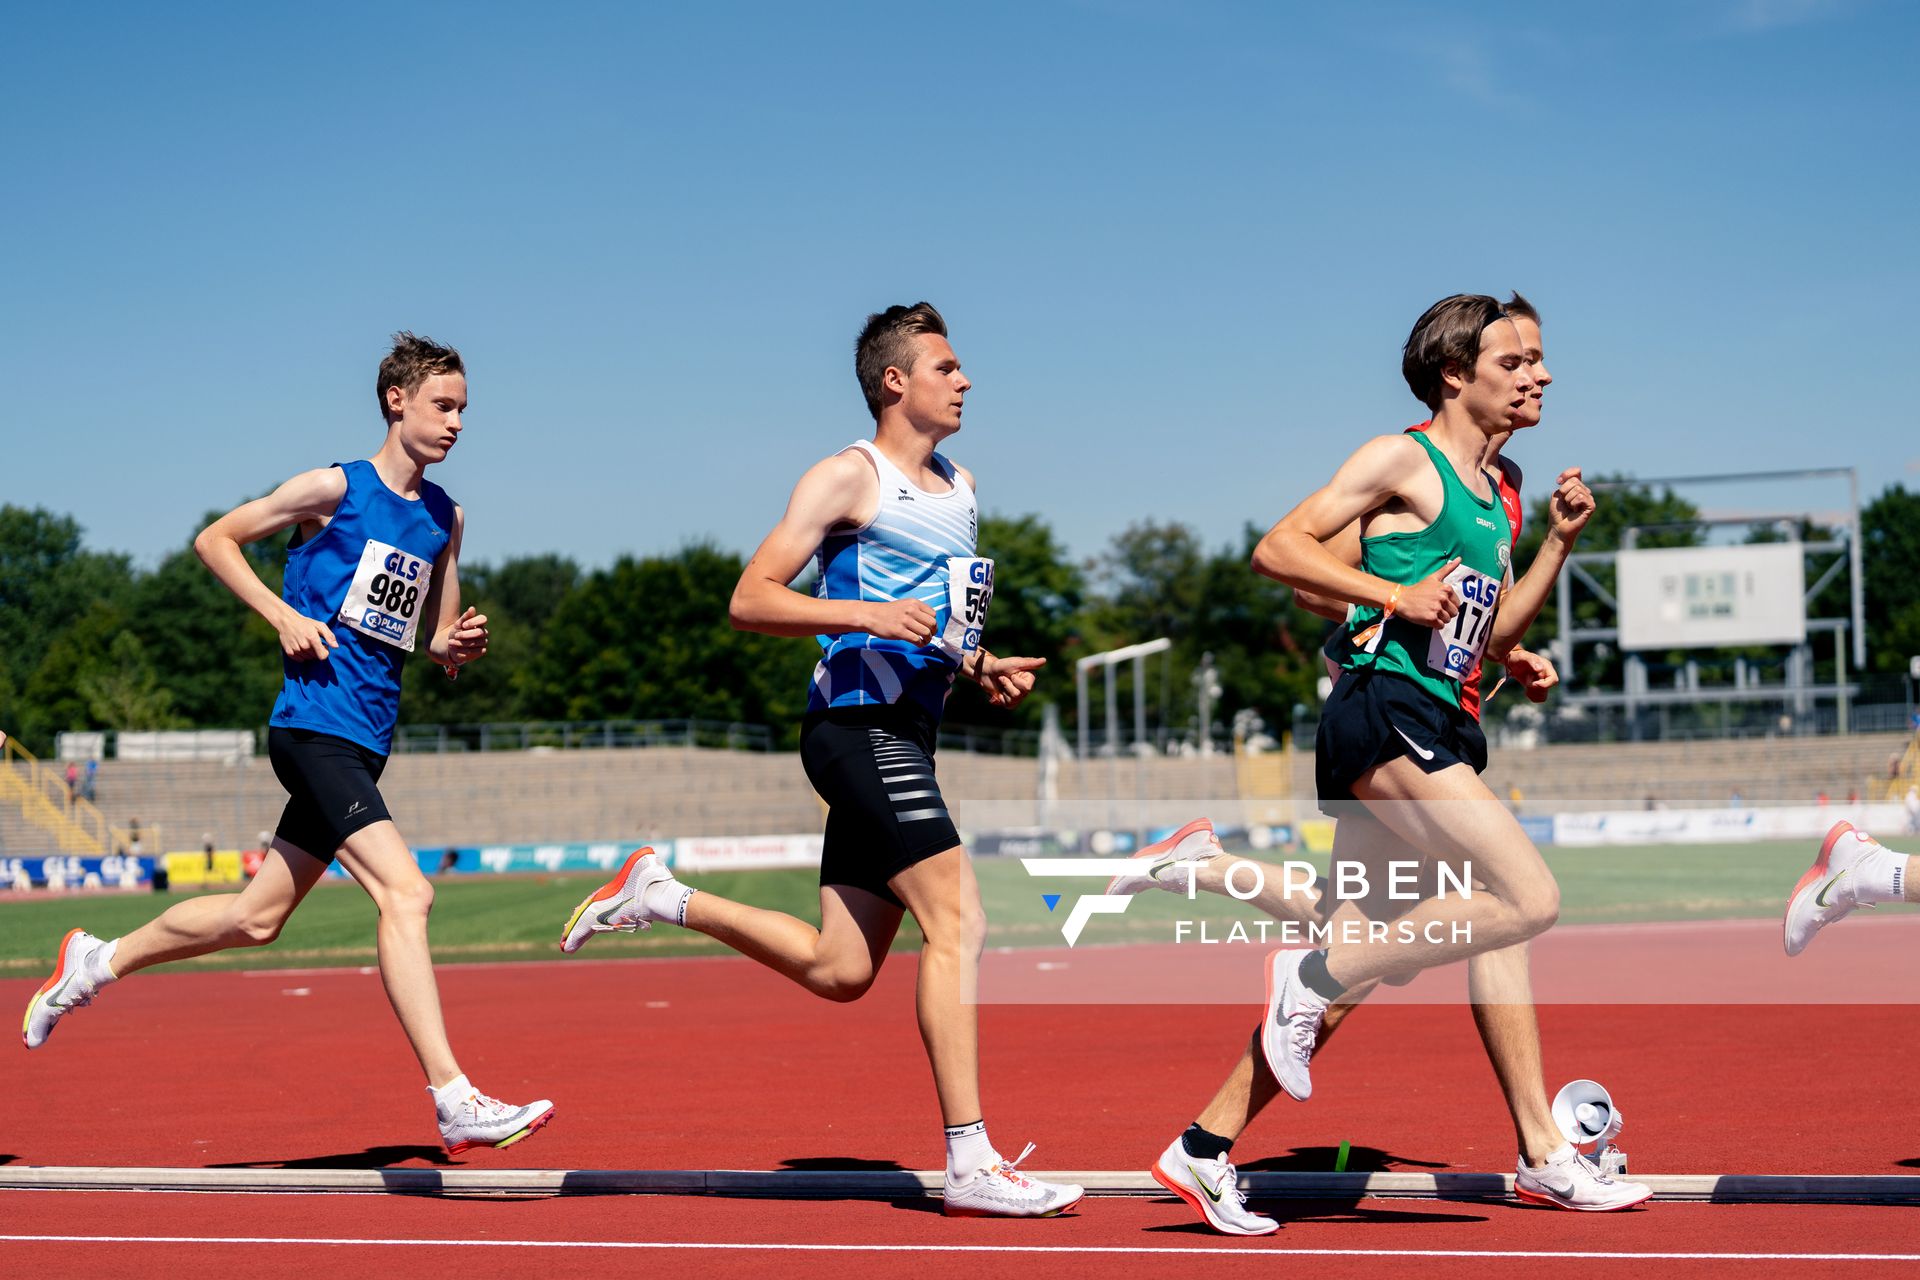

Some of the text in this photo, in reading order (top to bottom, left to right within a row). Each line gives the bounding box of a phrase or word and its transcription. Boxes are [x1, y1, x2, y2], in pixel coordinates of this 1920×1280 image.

[366, 573, 419, 619] 988
[1462, 575, 1497, 608] GLS
[381, 617, 405, 634] PLAN
